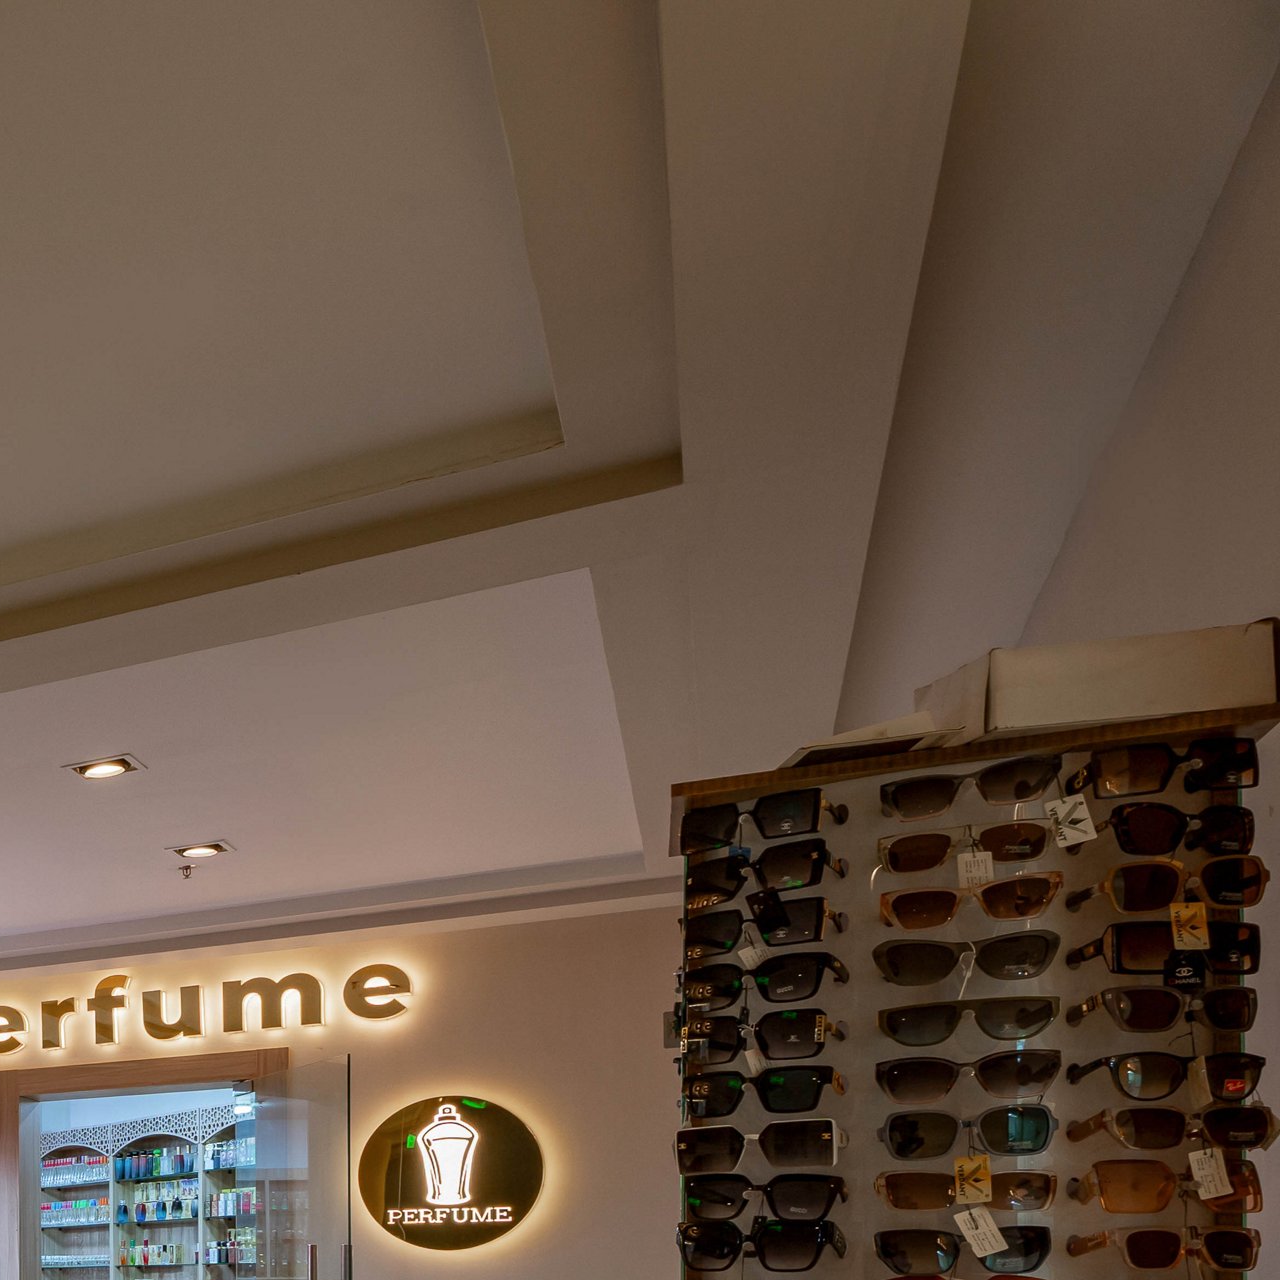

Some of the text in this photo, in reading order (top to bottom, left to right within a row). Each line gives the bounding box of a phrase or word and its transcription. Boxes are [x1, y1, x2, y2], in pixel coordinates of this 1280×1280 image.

[1168, 977, 1201, 985] CHANEL
[957, 1164, 967, 1197] VERDANT
[386, 1206, 513, 1225] PERFUME
